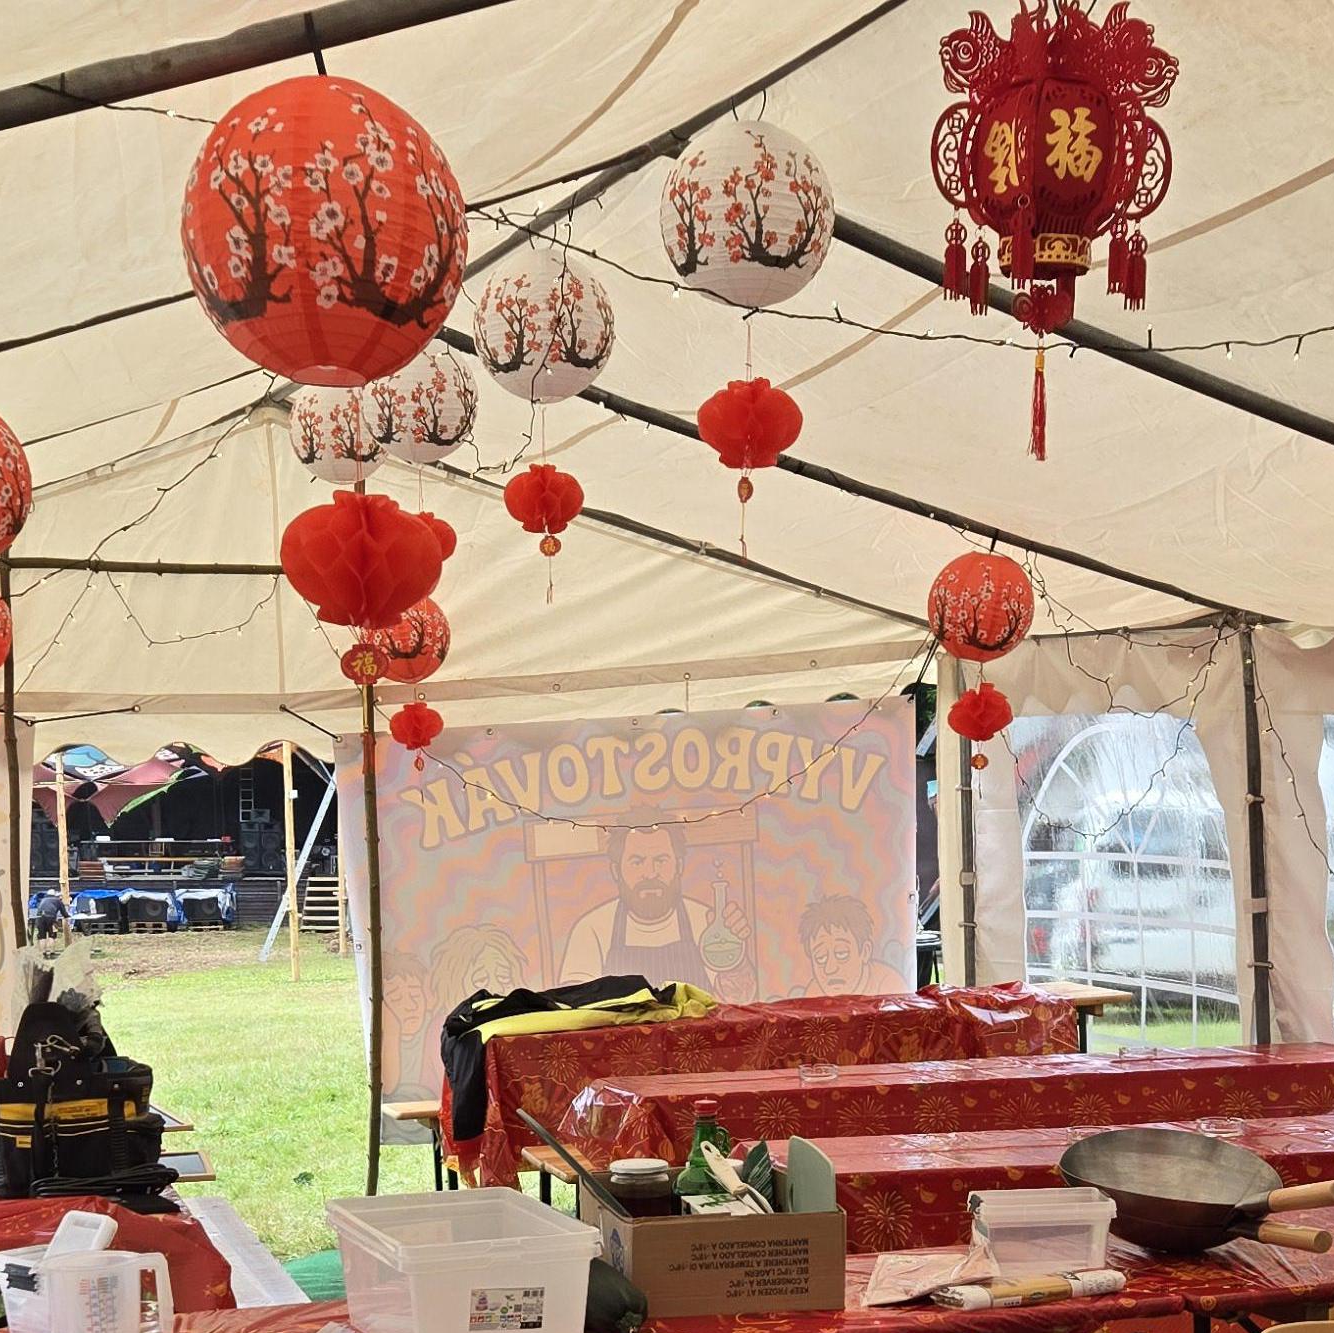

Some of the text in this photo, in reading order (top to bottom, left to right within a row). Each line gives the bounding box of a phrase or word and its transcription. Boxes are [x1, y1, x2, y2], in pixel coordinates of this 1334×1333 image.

[1046, 107, 1103, 182] 福
[351, 651, 377, 677] 福
[719, 1240, 766, 1250] CONGELADO
[767, 1238, 809, 1247] MANTENHA
[719, 1250, 765, 1259] CONGELADO
[768, 1248, 809, 1257] MANTENER
[698, 1261, 754, 1270] TEMPERATURA
[763, 1257, 809, 1267] MANTENERE
[744, 1269, 775, 1278] LAGERN
[757, 1278, 802, 1286] CONSERVER
[746, 1288, 757, 1296] AT
[758, 1287, 788, 1296] FROZEN
[790, 1286, 809, 1296] KEEP
